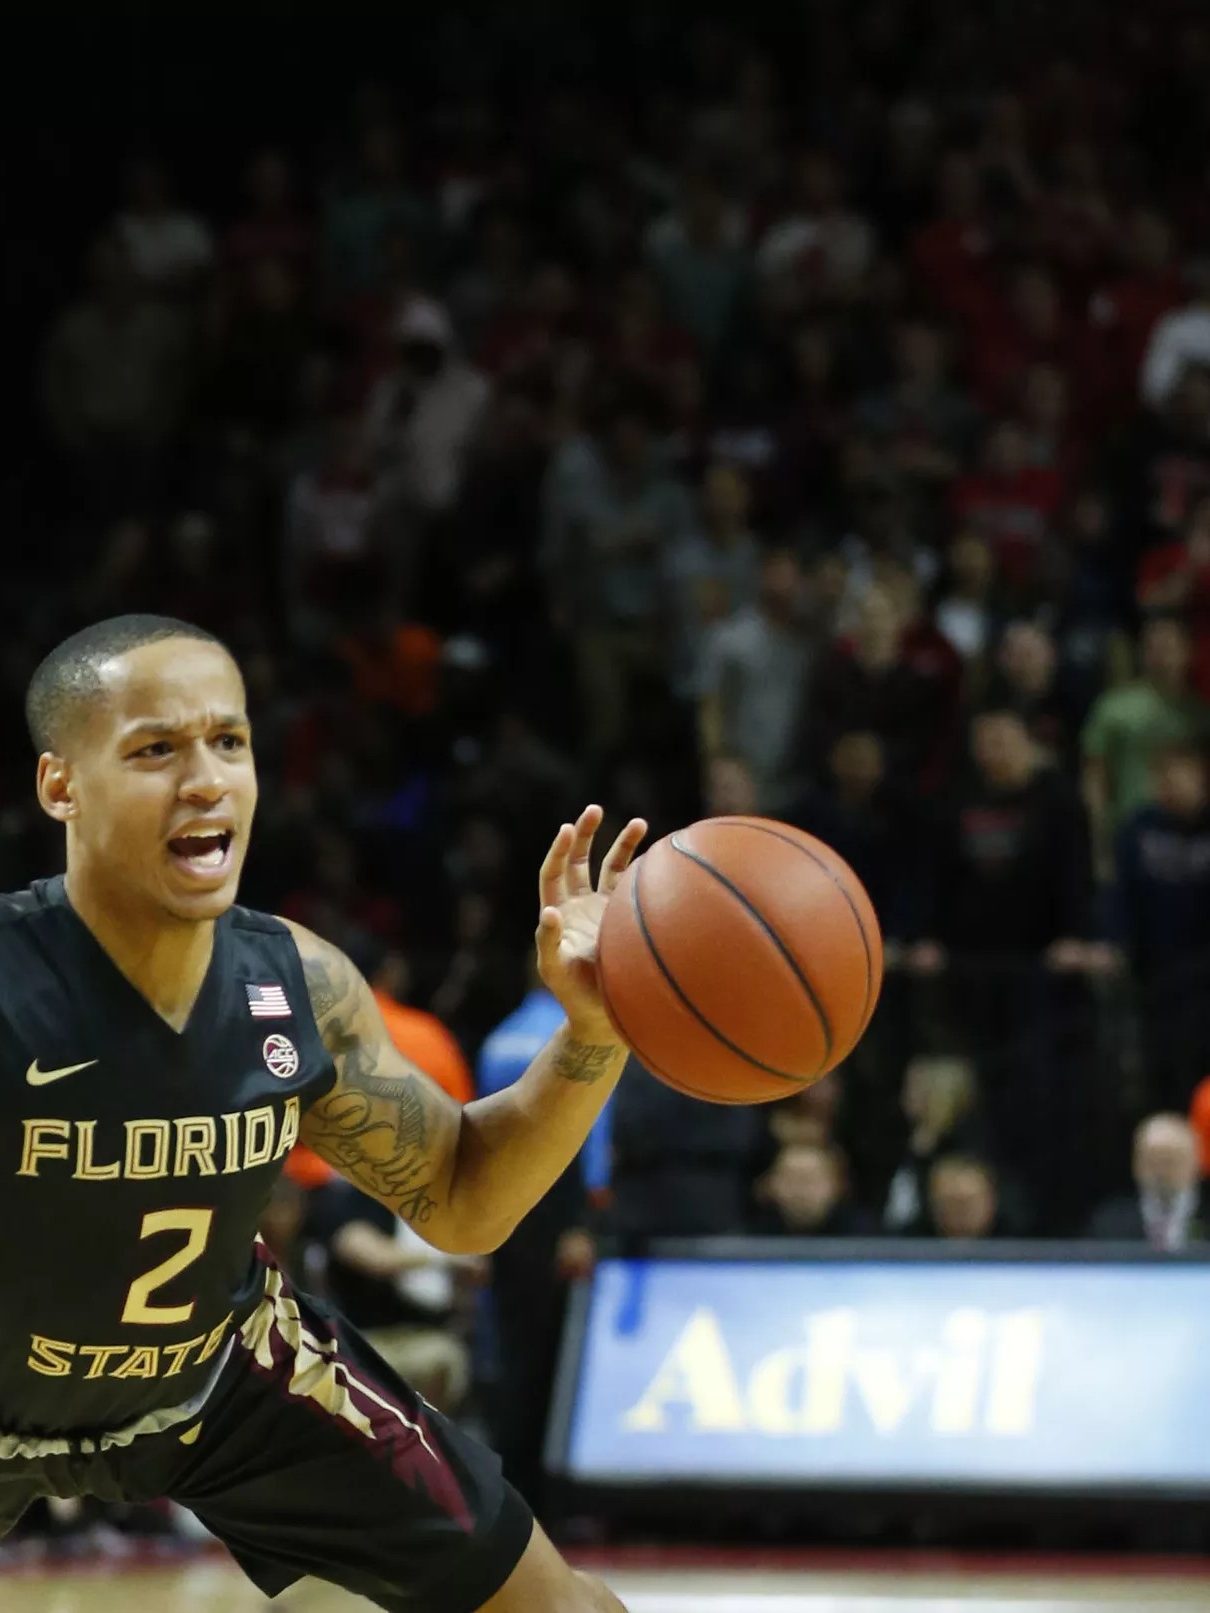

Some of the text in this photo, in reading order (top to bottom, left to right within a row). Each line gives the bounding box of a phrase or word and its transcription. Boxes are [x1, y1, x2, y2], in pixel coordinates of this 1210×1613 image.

[15, 1096, 301, 1181] FLORIDA
[119, 1207, 215, 1326] 2
[621, 1305, 1044, 1435] Advil
